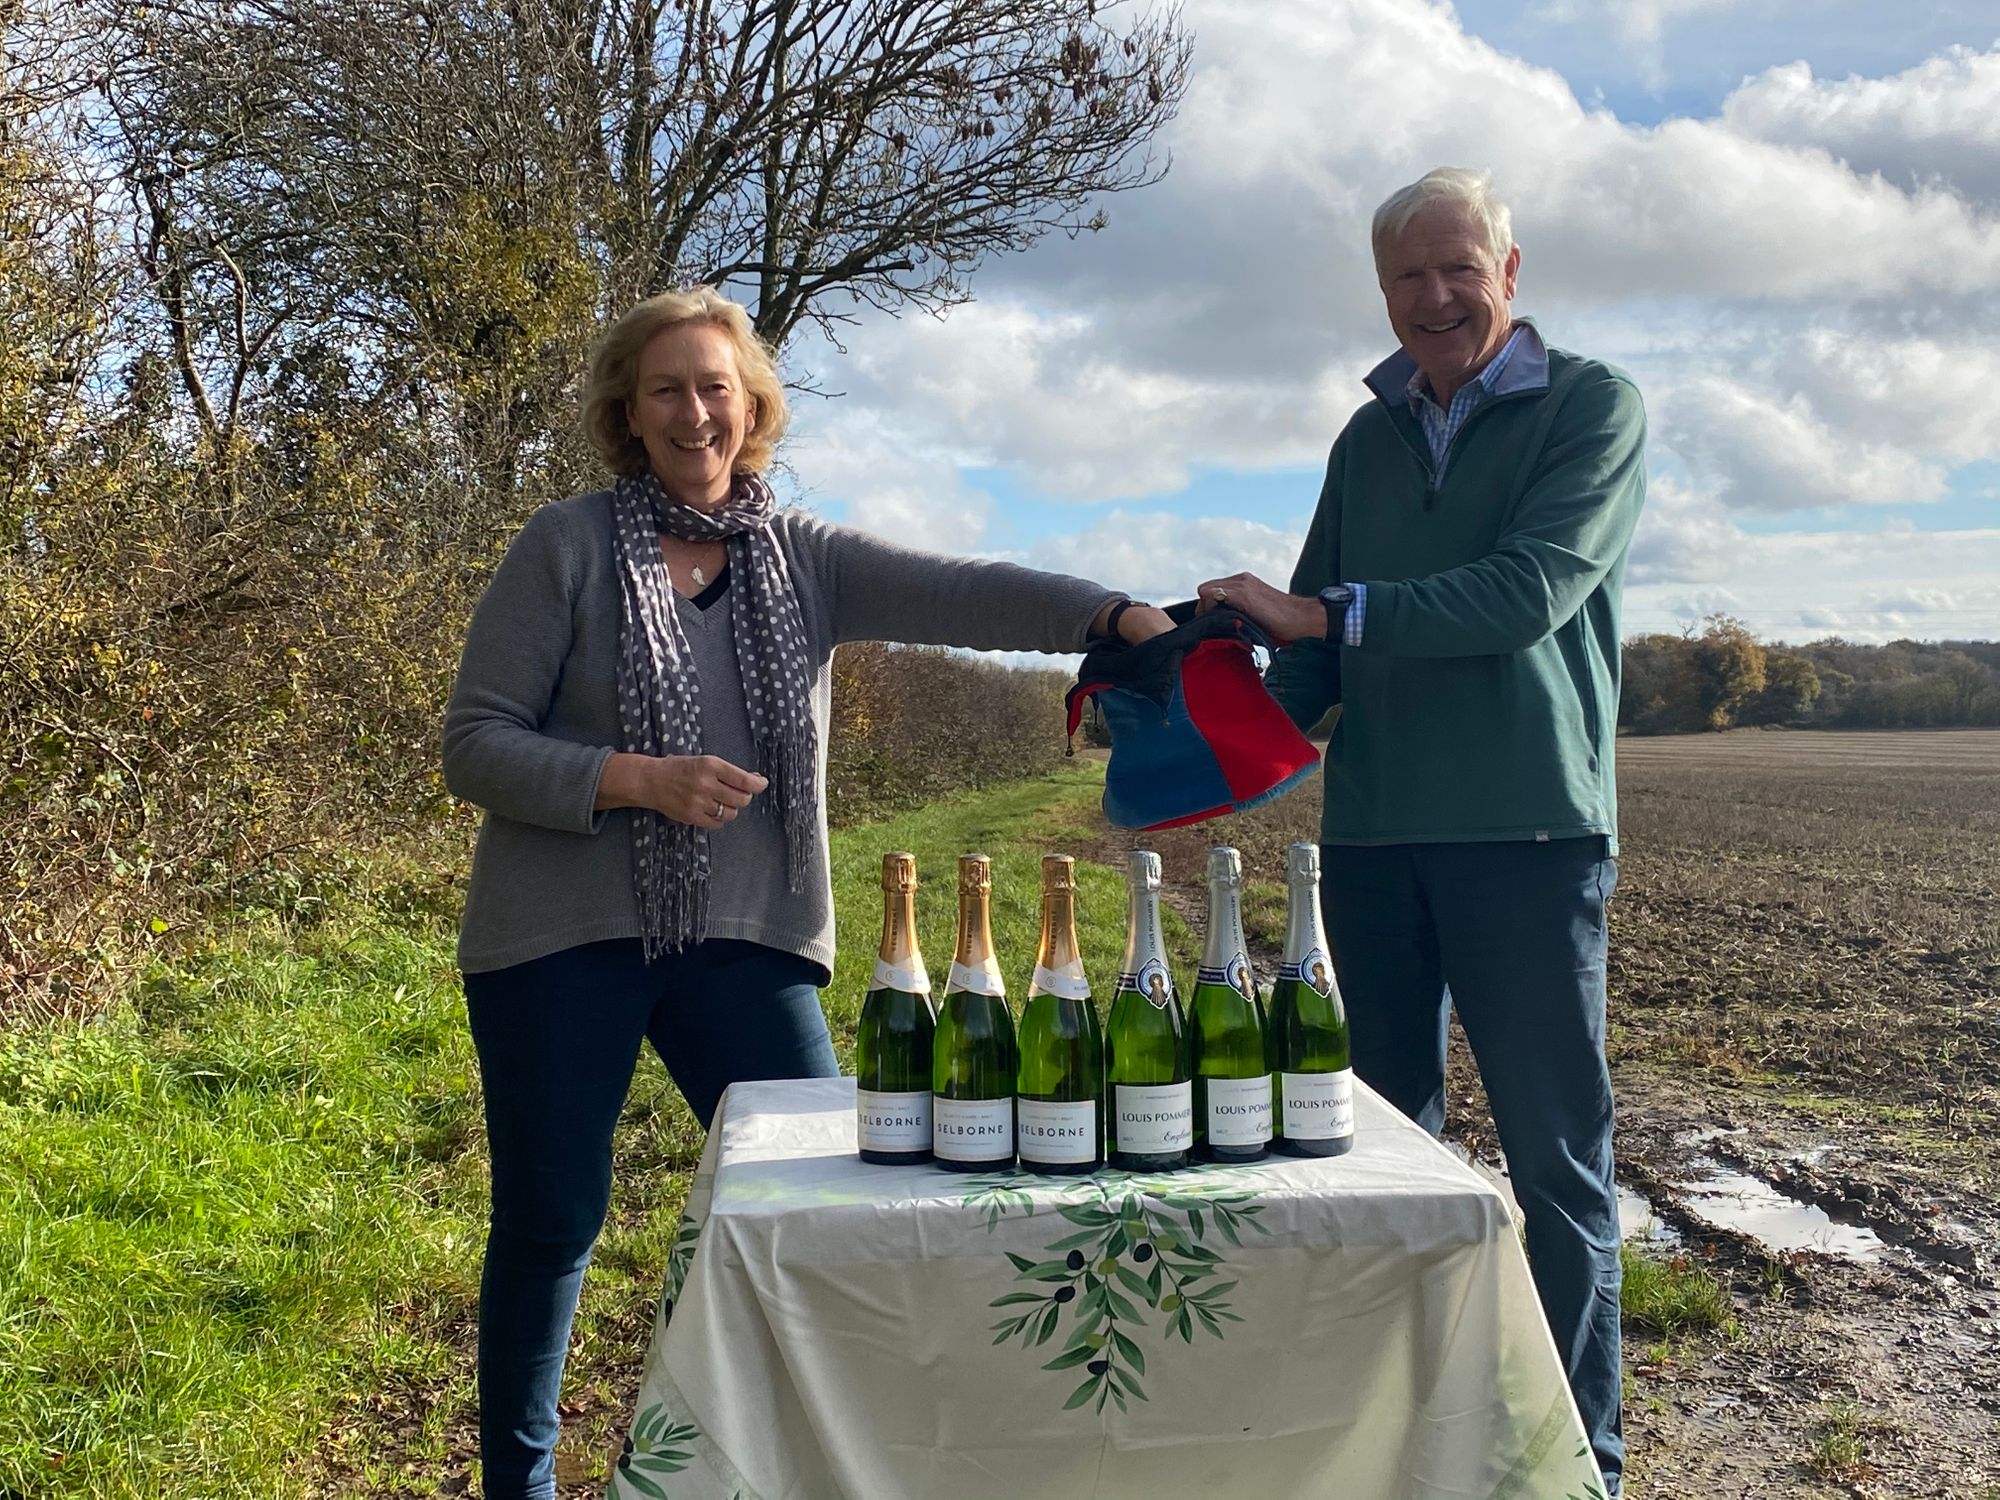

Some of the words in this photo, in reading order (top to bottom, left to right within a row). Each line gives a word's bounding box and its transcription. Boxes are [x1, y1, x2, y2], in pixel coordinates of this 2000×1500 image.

[1289, 1099, 1319, 1109] LOUIS
[1216, 1105, 1246, 1115] LOUIS
[859, 1114, 921, 1126] SELBORNE
[1122, 1112, 1152, 1123] LOUIS
[938, 1123, 1003, 1135] SELBORNE
[1020, 1124, 1084, 1137] SELBORNE
